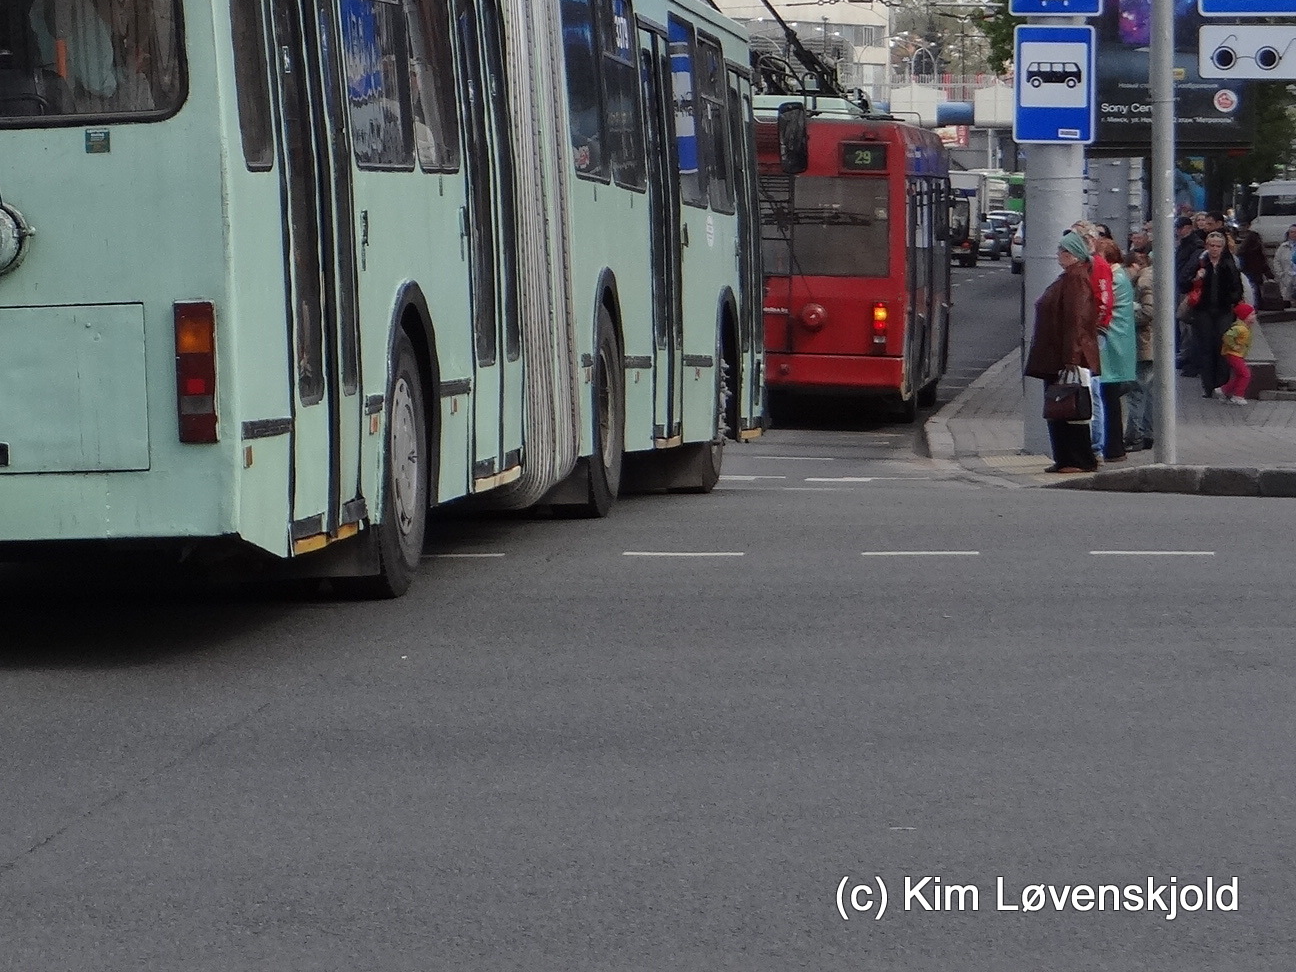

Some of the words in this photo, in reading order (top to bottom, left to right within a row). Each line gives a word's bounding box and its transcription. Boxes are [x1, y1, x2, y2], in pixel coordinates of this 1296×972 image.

[1101, 103, 1129, 114] Sony
[1131, 103, 1153, 113] Cen
[854, 150, 872, 164] 29
